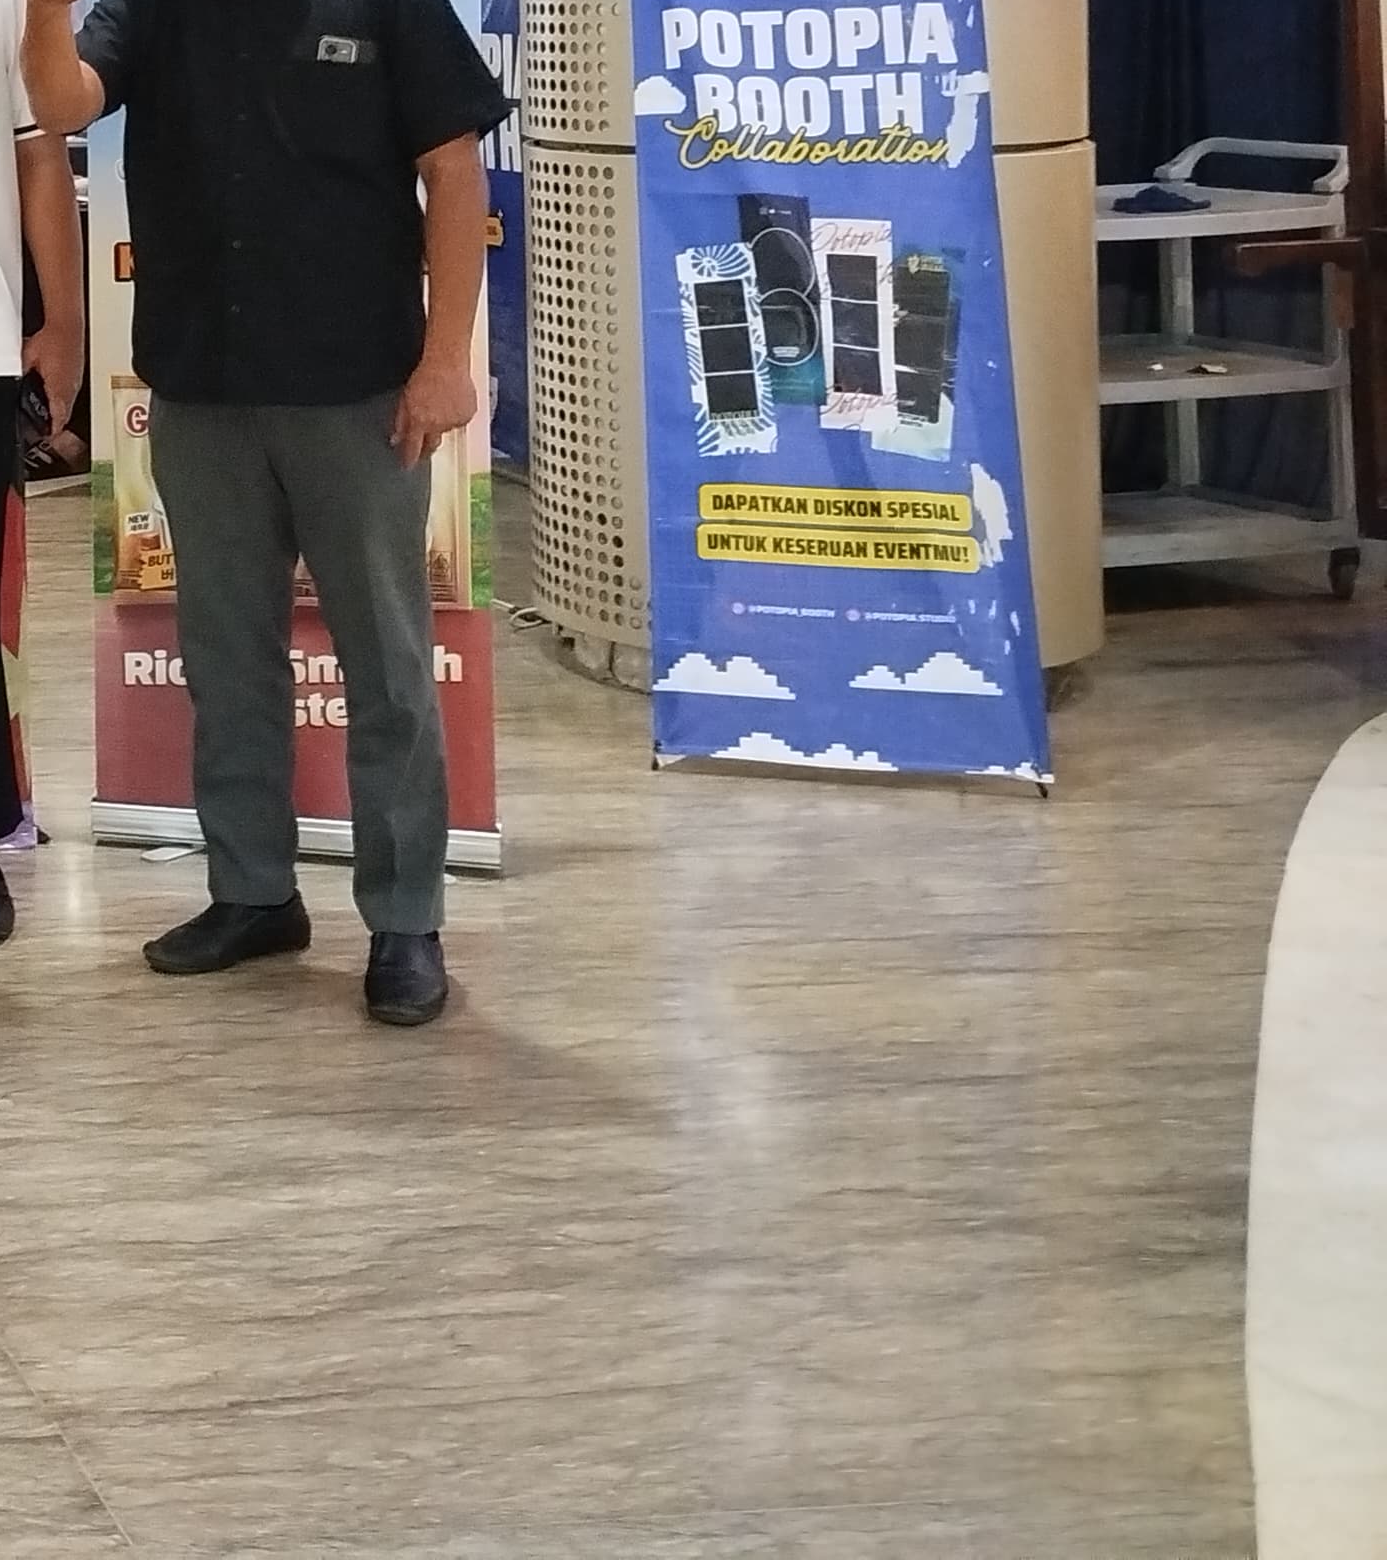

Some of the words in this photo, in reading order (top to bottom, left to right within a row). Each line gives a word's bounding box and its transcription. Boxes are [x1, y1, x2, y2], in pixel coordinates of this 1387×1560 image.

[661, 2, 959, 70] POTOPIA
[693, 72, 924, 137] BOOTH
[663, 115, 951, 170] Collaboration
[128, 514, 150, 524] NEW
[711, 494, 808, 515] DAPATKAN
[813, 498, 882, 519] DISKON
[887, 502, 961, 522] SPESIAL
[707, 533, 767, 553] UNTUK
[773, 536, 868, 559] KESERUAN
[874, 542, 969, 563] EVENTMU!
